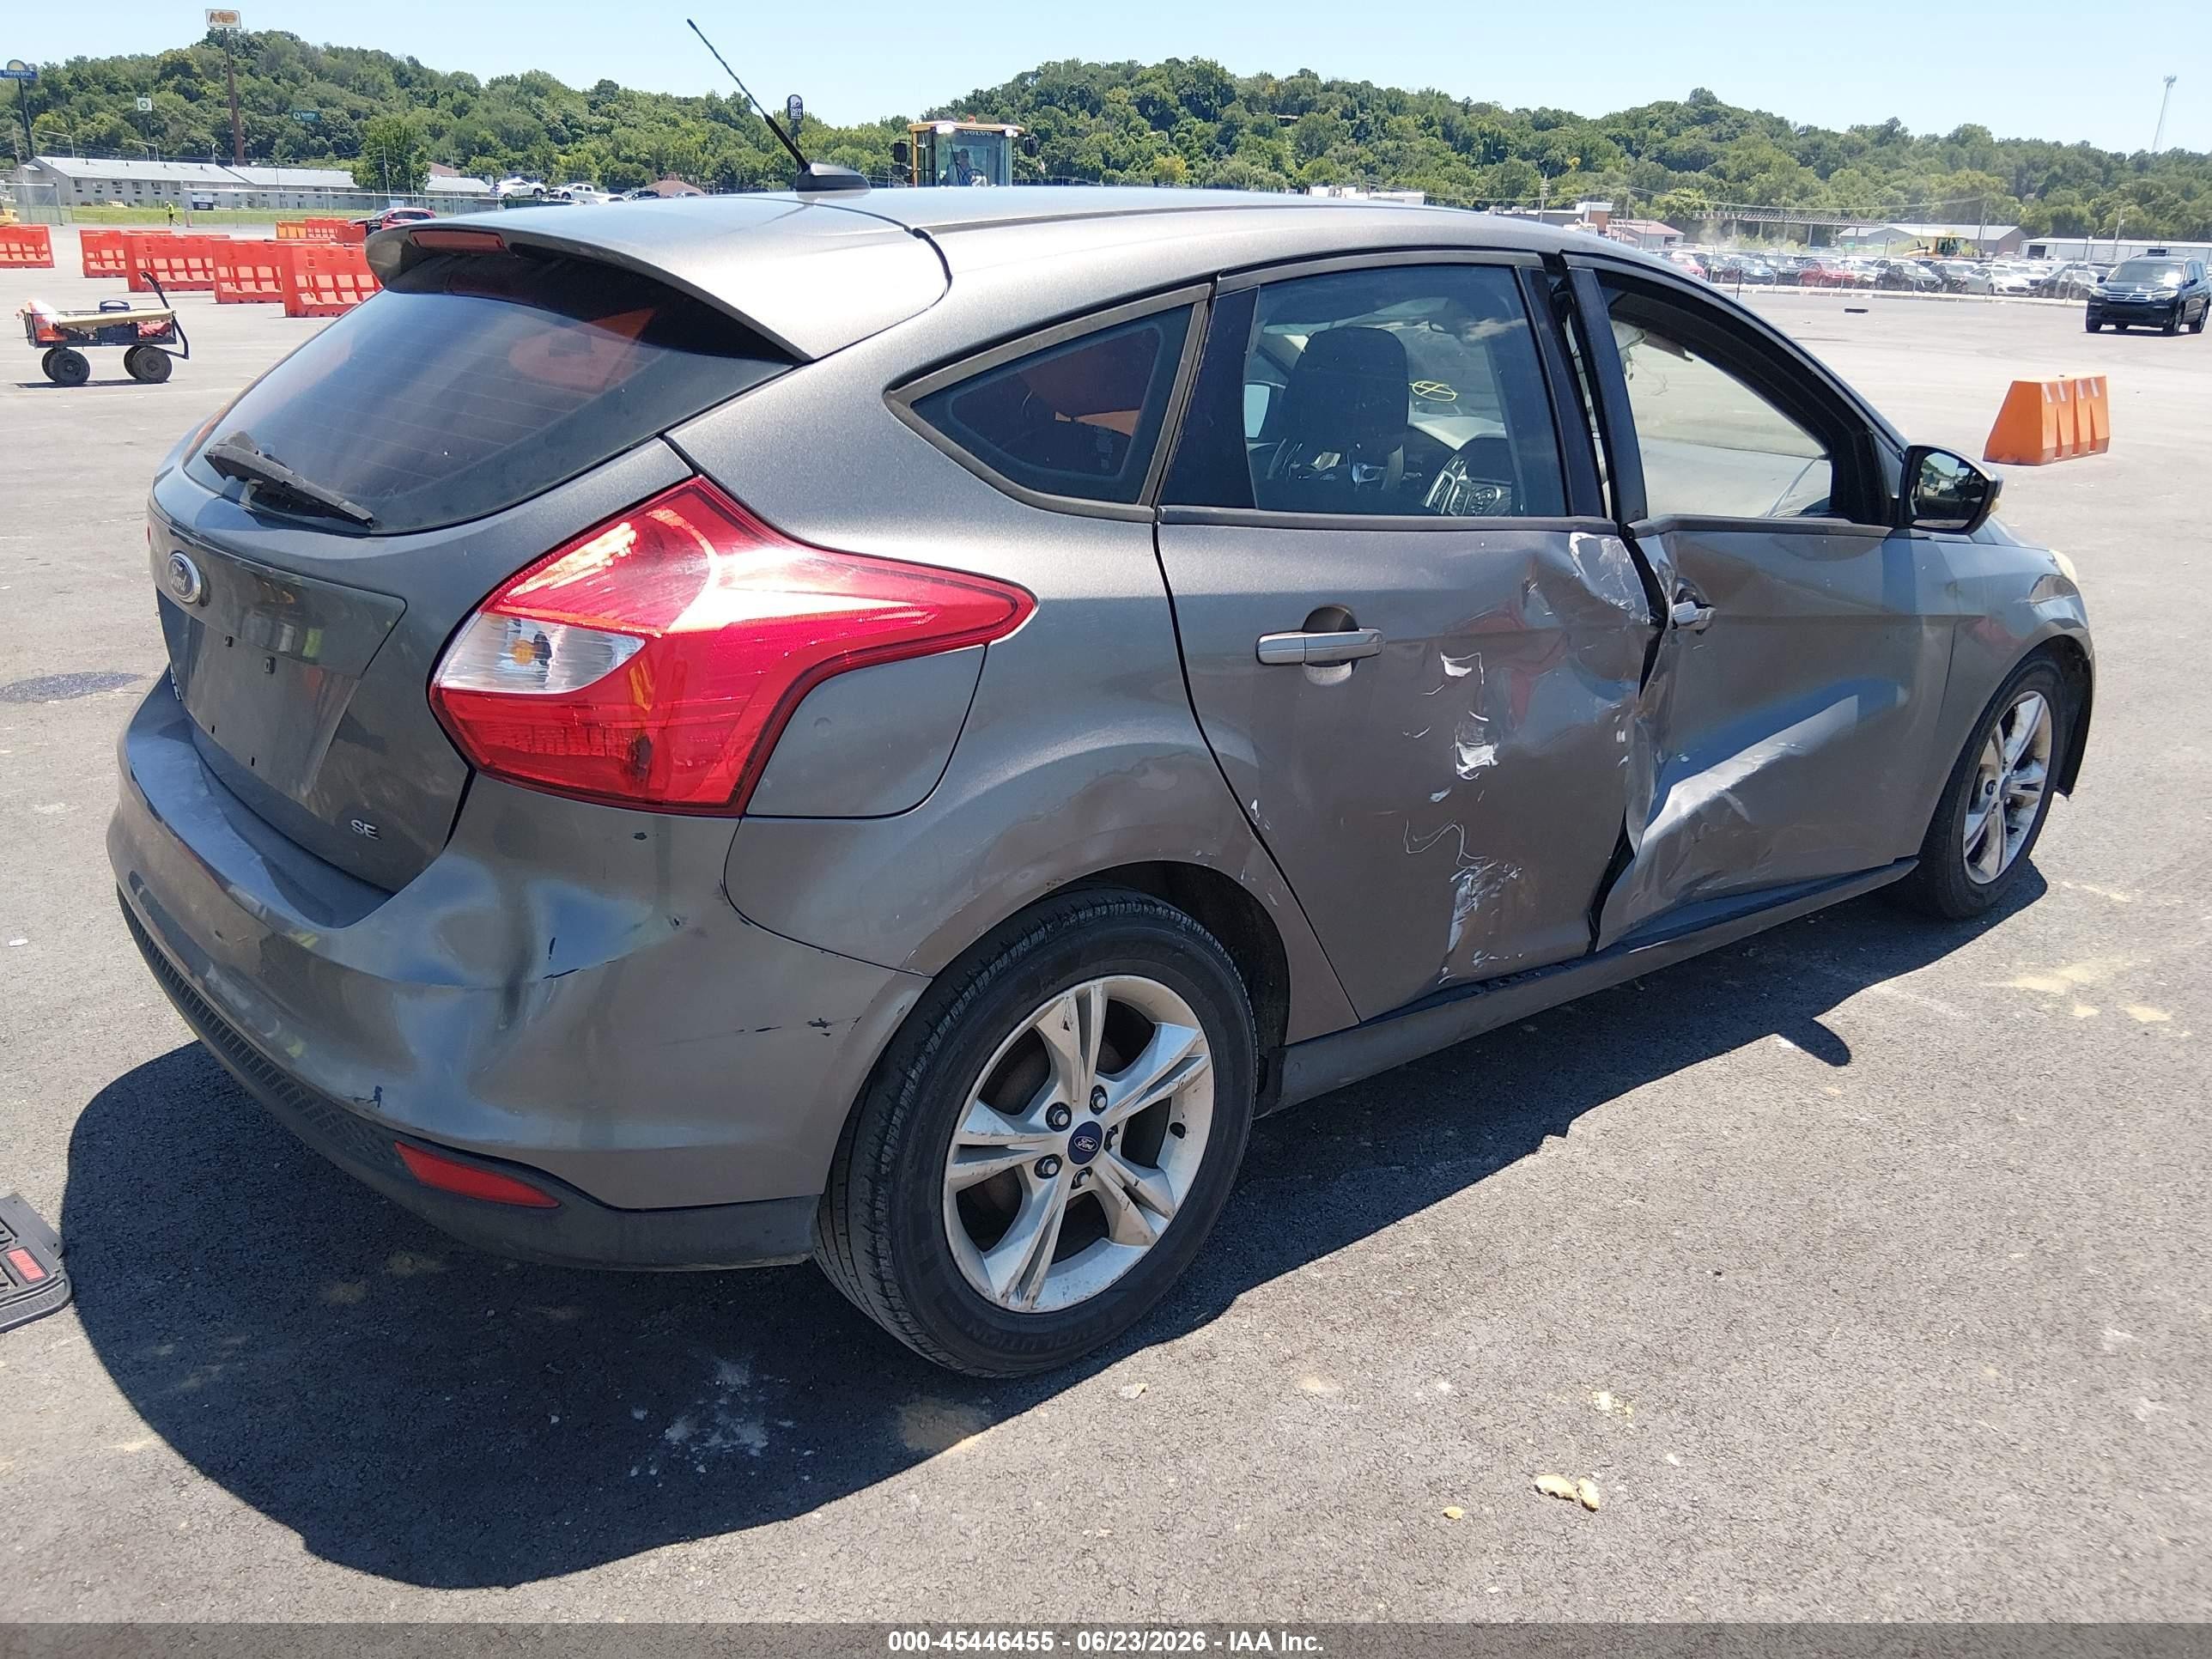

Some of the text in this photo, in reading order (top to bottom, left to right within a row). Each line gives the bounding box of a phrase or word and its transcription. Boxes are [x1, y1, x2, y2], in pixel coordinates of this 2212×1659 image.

[170, 562, 187, 592] Ford
[350, 819, 379, 840] SE
[1078, 1138, 1096, 1151] Ford
